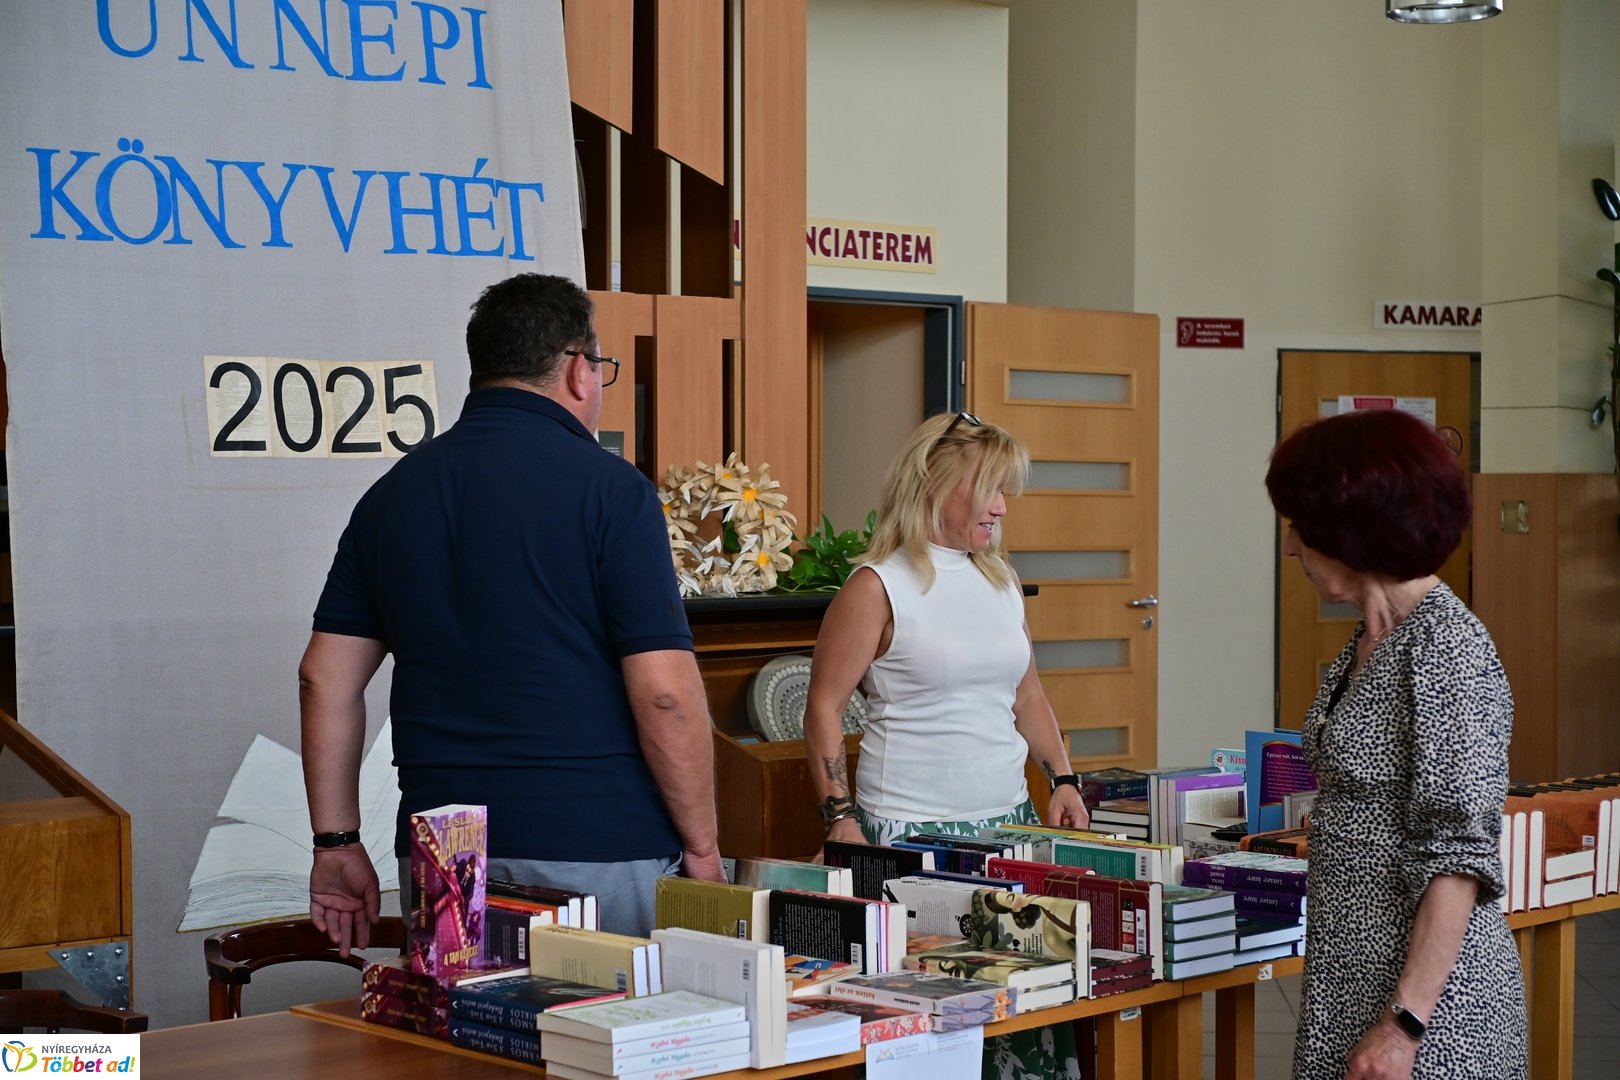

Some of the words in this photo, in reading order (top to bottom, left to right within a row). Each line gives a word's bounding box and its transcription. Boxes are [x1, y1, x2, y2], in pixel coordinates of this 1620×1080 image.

[26, 138, 544, 261] KÖNYVHÉT
[1384, 304, 1482, 326] KAMARA
[209, 361, 435, 453] 2025
